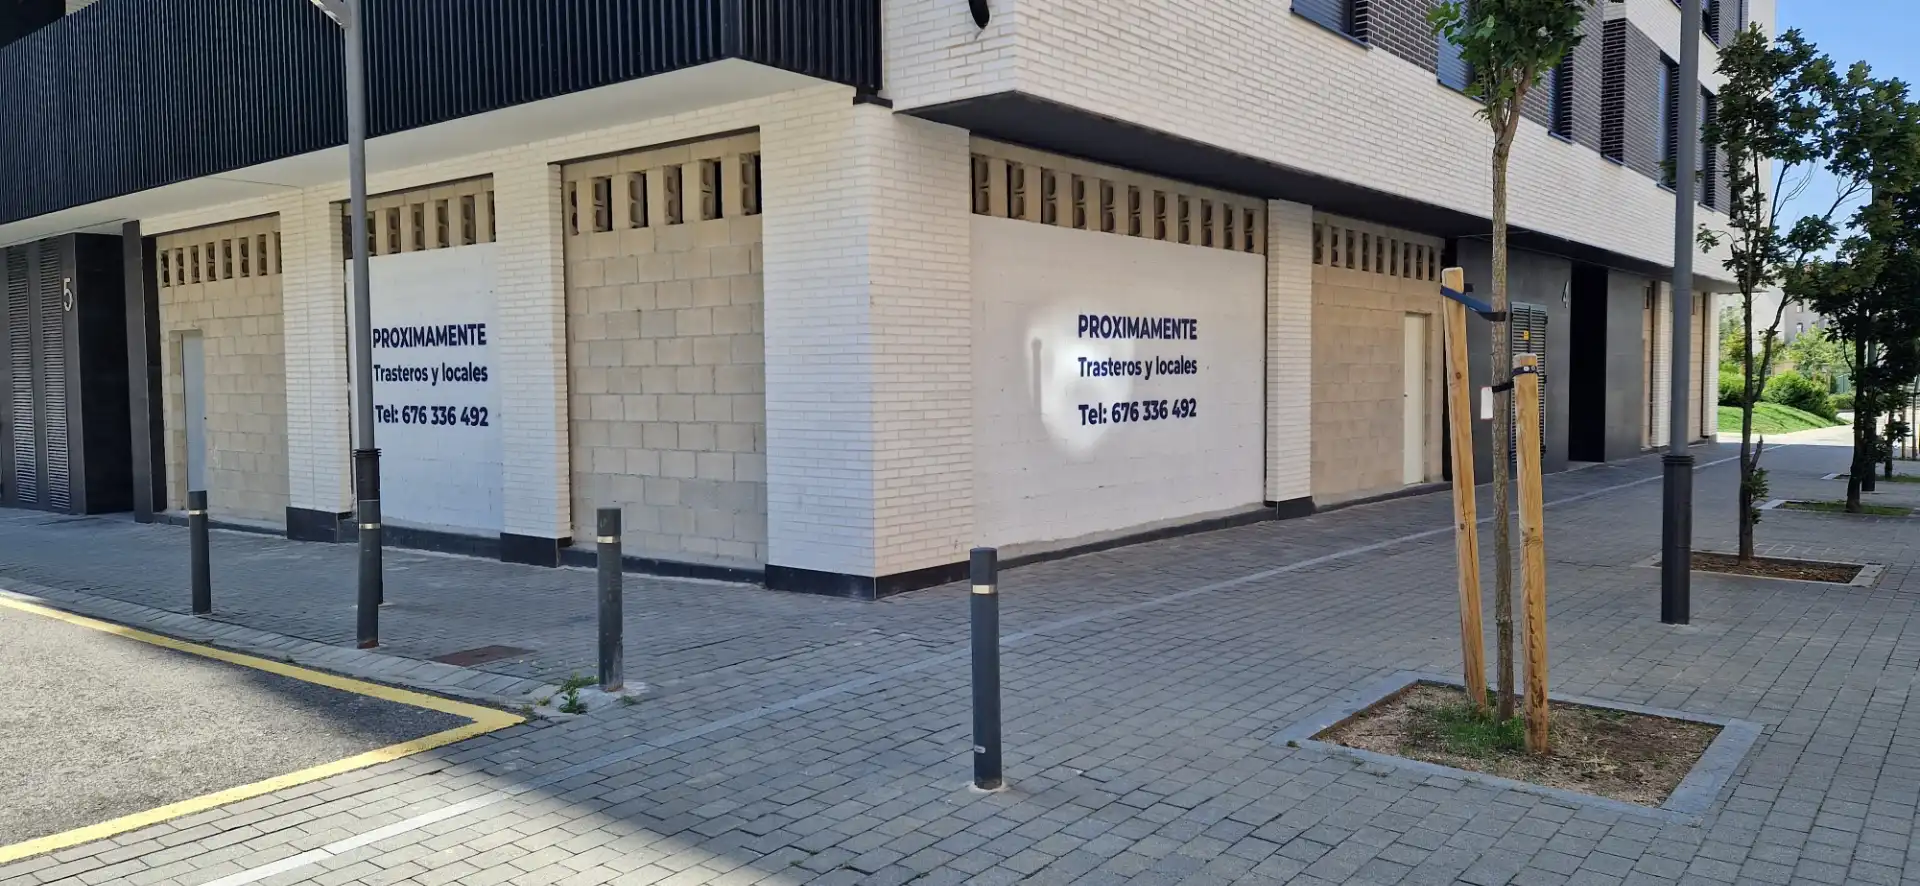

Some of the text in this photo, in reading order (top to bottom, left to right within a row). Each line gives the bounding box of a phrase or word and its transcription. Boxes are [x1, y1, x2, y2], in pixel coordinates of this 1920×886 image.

[63, 277, 73, 311] 5
[1561, 280, 1569, 309] 4
[373, 323, 487, 348] PROXIMAMENTE
[1078, 314, 1197, 340] PROXIMAMENTE
[374, 361, 488, 386] Trasteros y locales
[1078, 355, 1197, 380] Trasteros y locales
[375, 404, 489, 426] Tel: 676 336 492
[1078, 398, 1197, 425] Tel: 676 336 492
